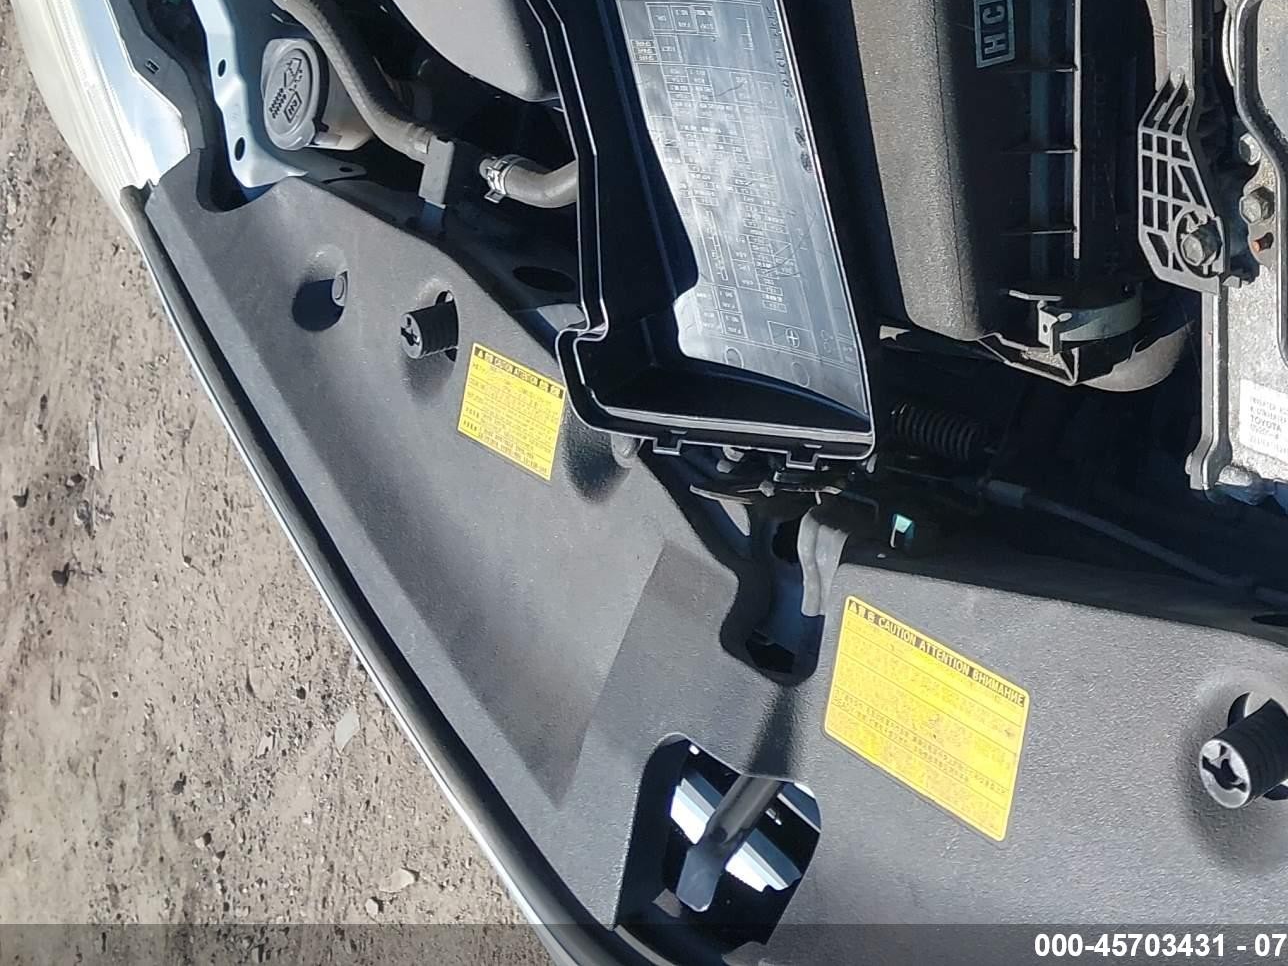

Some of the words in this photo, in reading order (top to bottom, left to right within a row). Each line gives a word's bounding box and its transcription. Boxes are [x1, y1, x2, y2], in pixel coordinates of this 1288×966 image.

[1250, 414, 1281, 432] TOYOTA
[878, 616, 917, 647] CAUTION
[919, 639, 970, 676] ATTENTION
[972, 668, 1025, 706] ВНИМАНИЕ
